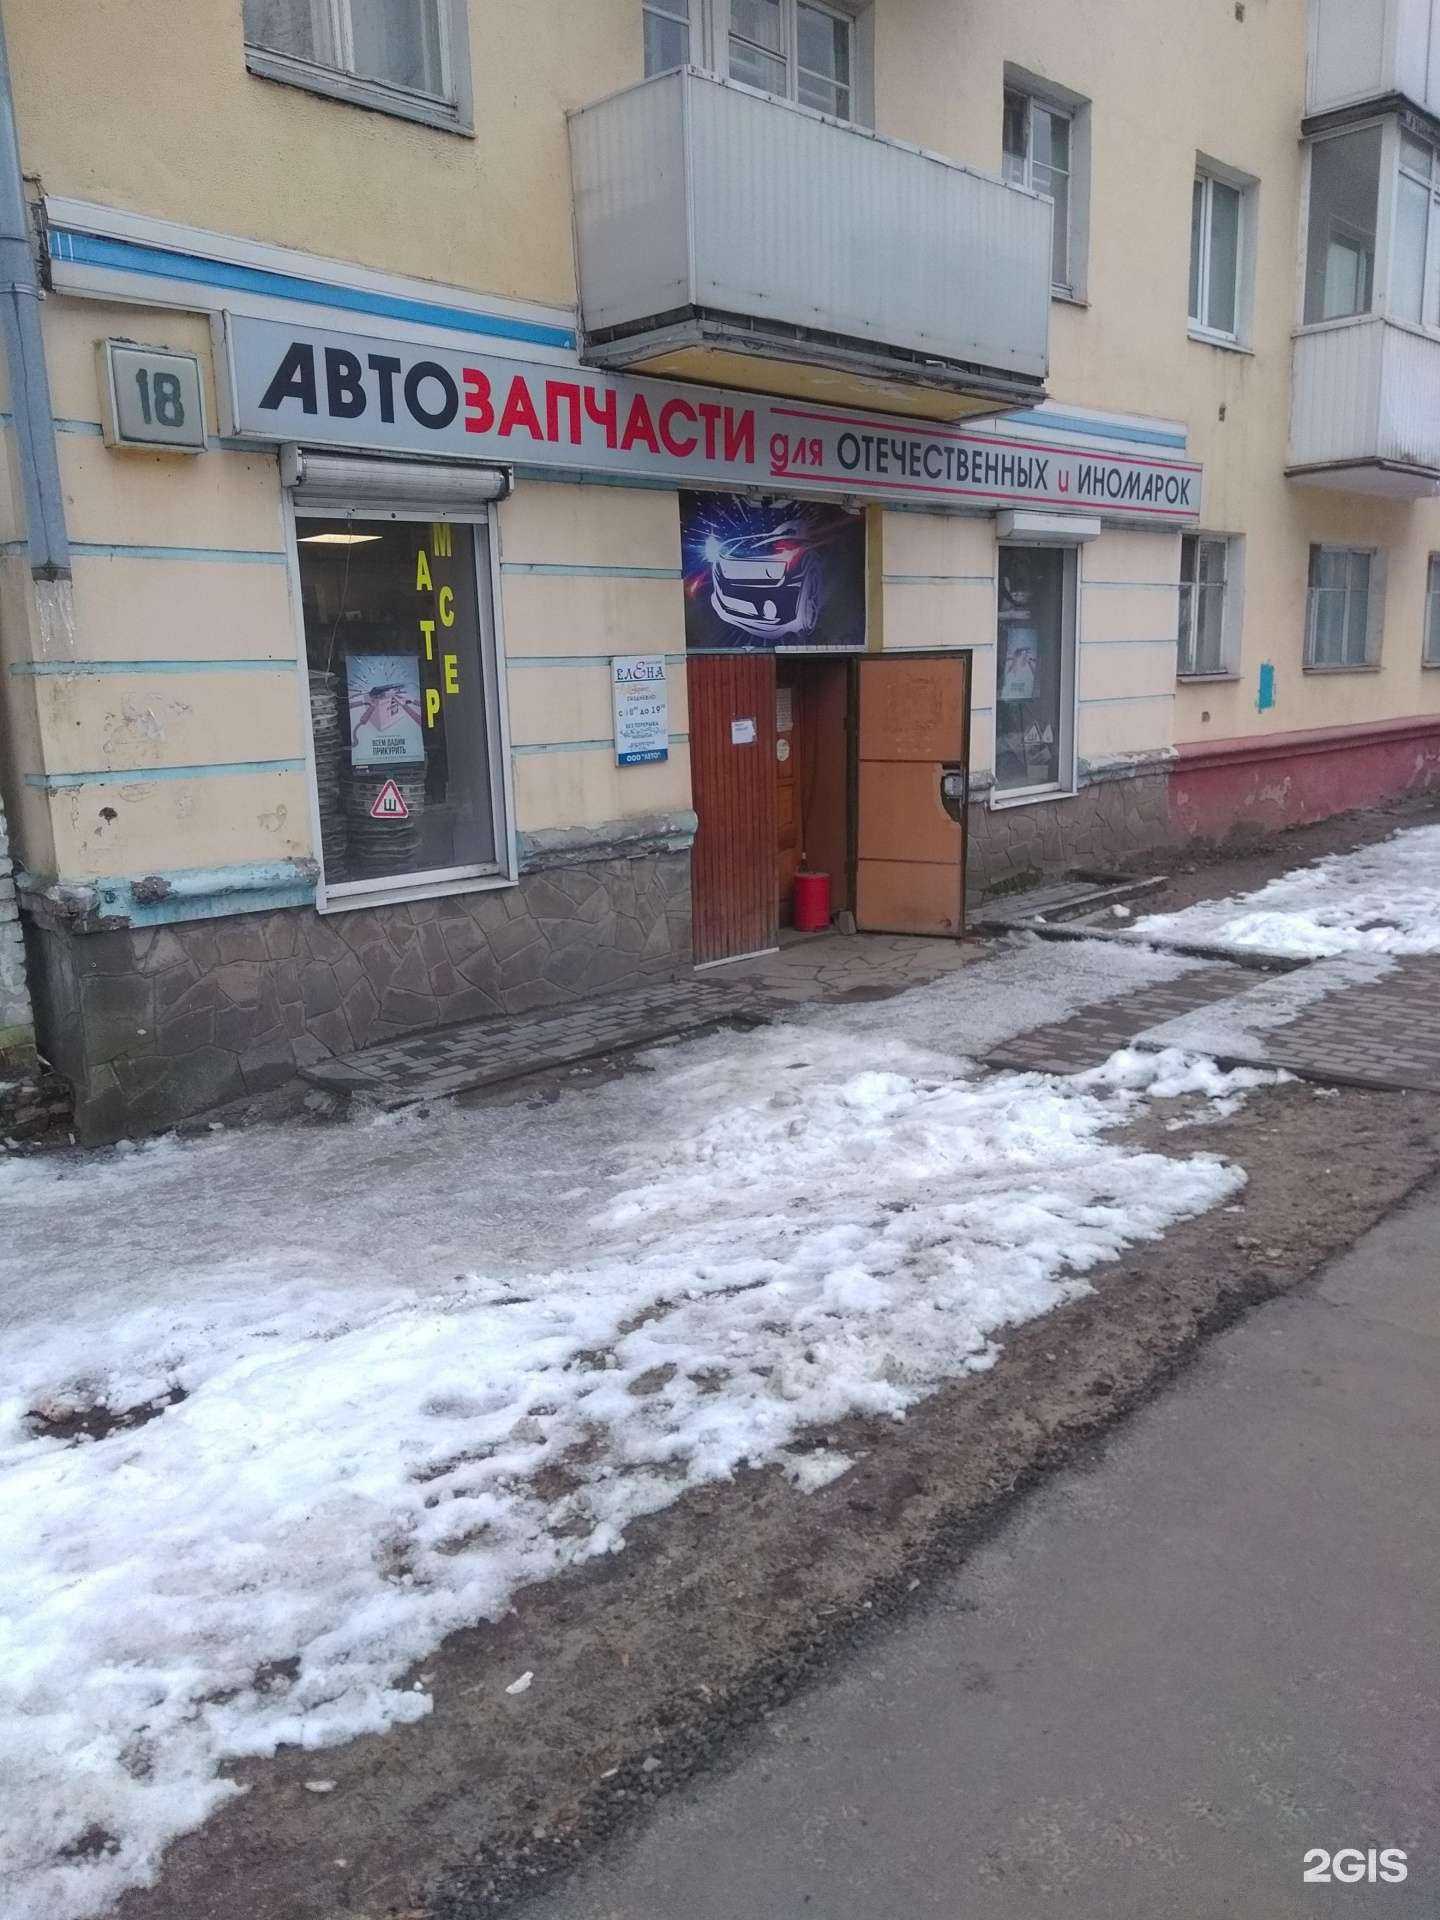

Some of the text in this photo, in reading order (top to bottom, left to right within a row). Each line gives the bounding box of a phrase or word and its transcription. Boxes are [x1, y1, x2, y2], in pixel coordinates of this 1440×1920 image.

[135, 368, 185, 427] 18
[259, 342, 1190, 505] АВТОЗАПЧАСТИ для ОТЕЧЕСТВЕННЫХ и ИНОМАРОК
[384, 799, 397, 811] Ш
